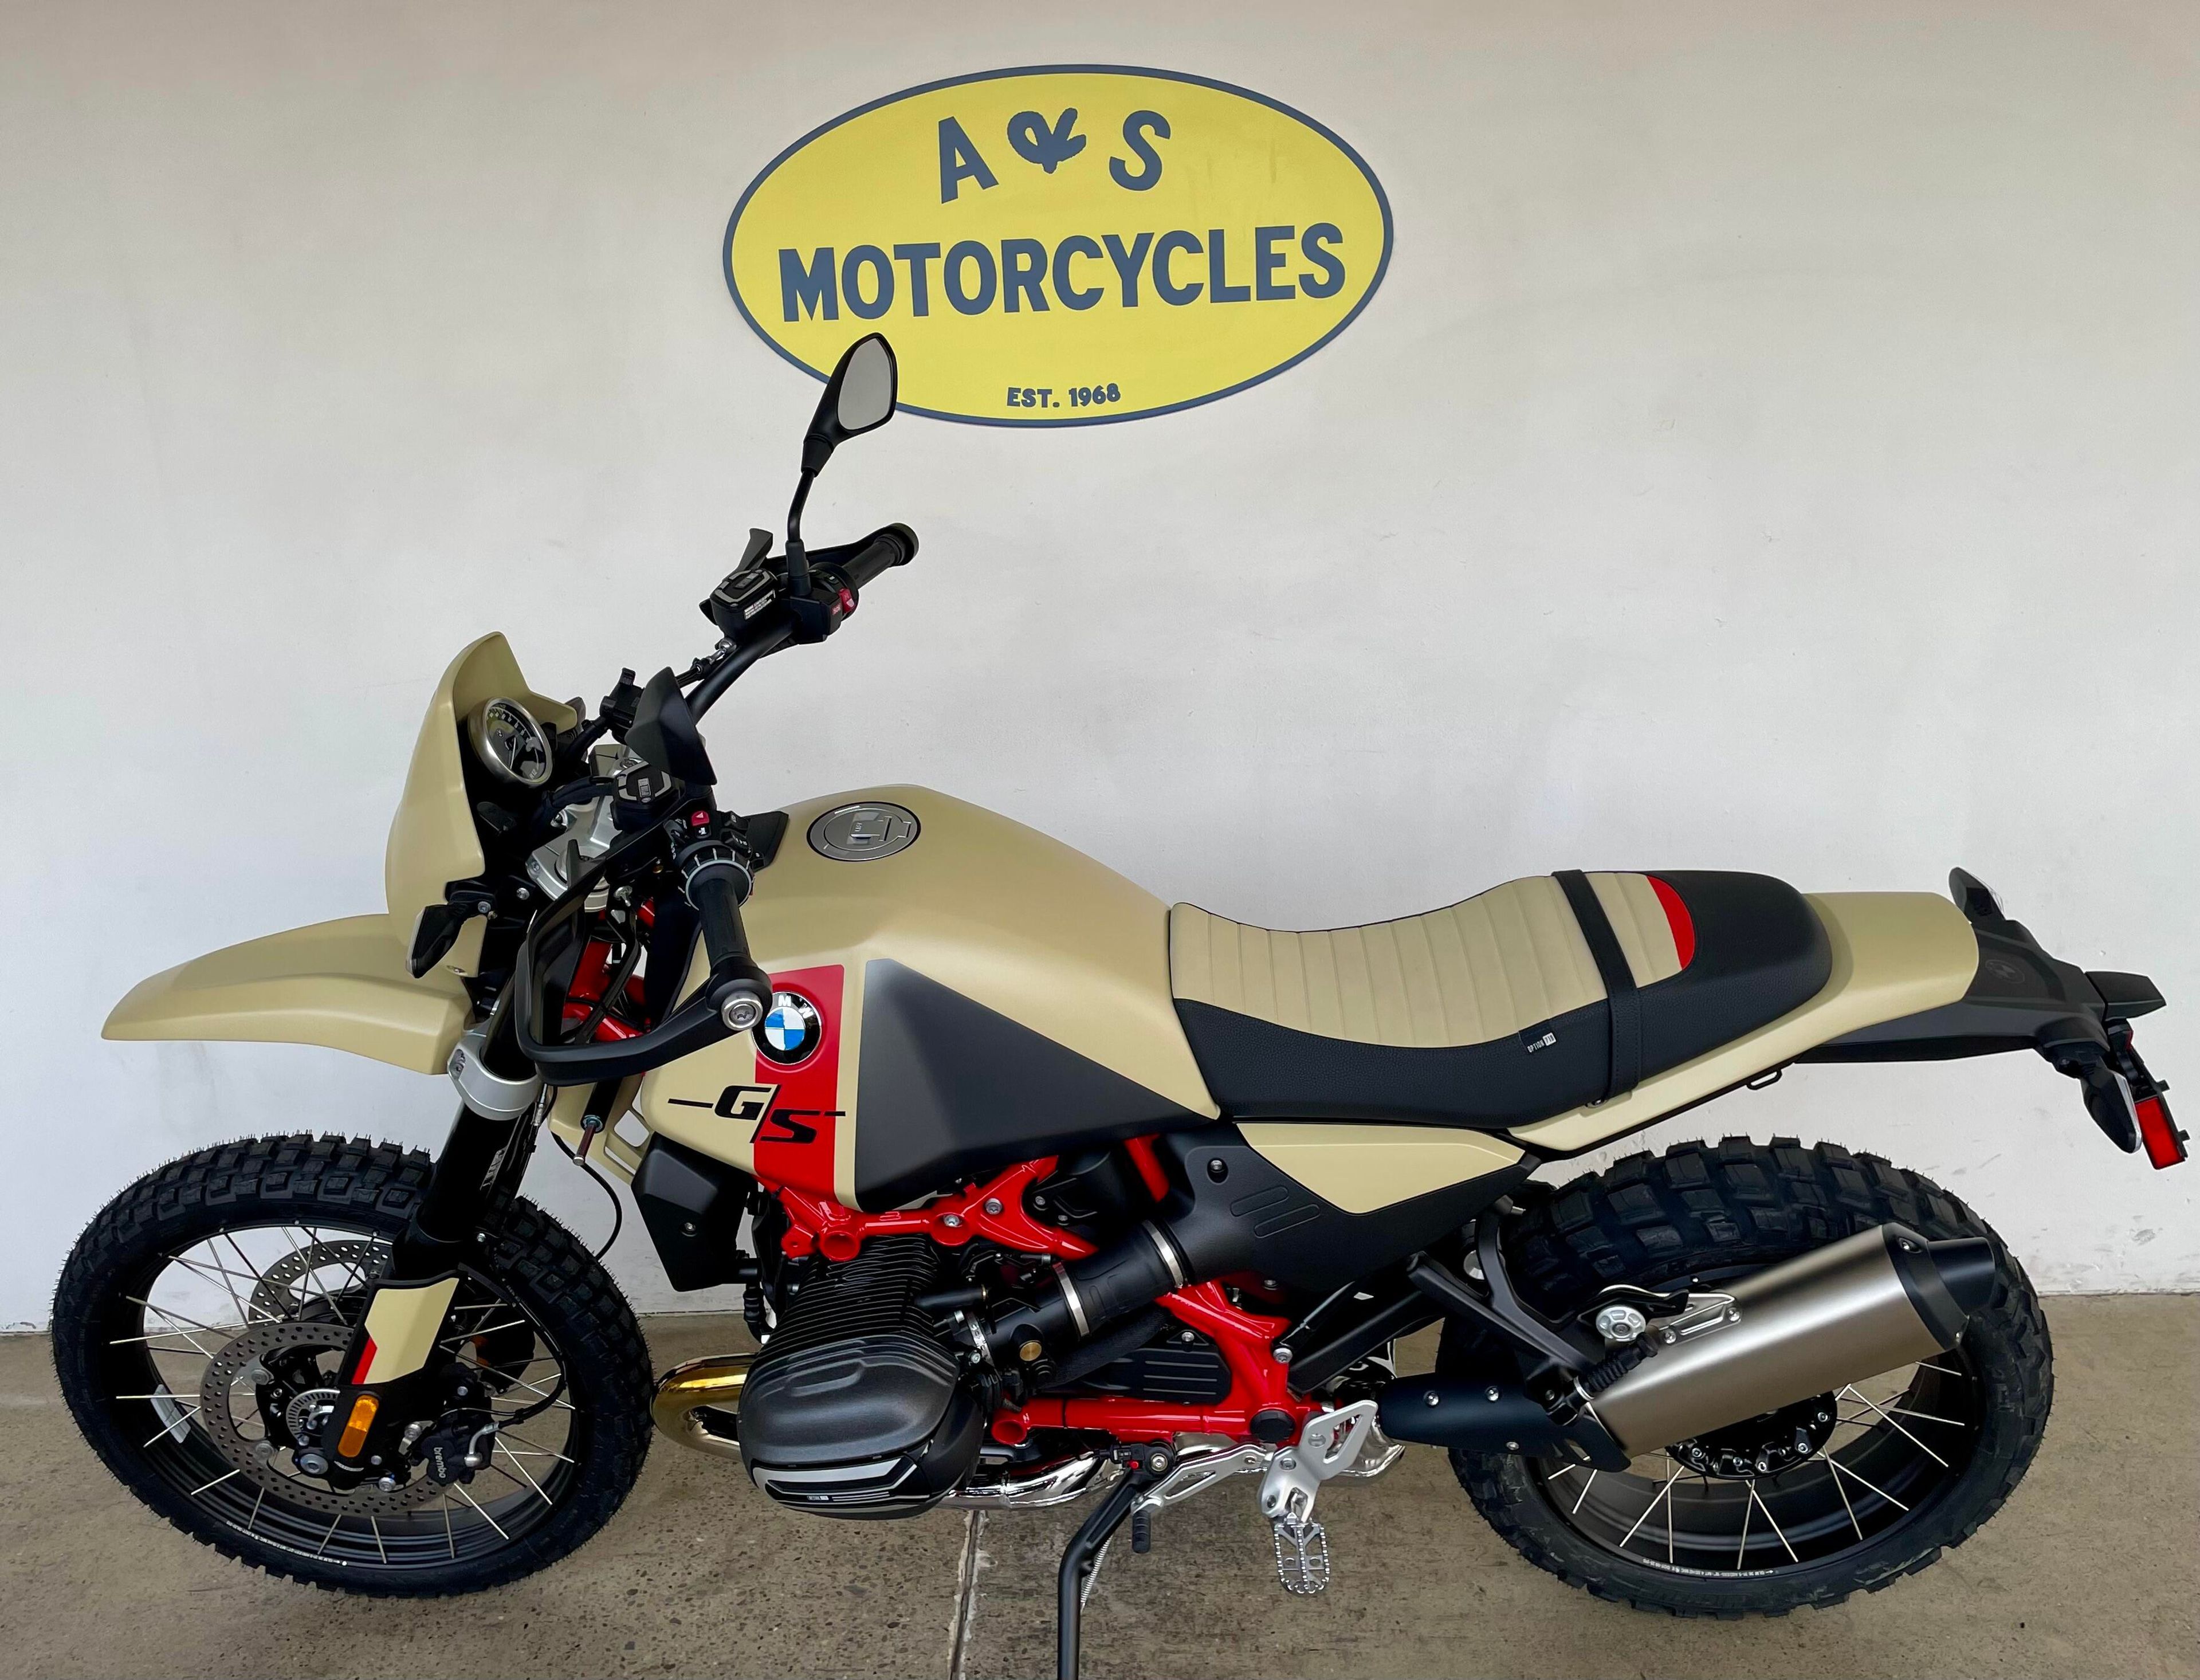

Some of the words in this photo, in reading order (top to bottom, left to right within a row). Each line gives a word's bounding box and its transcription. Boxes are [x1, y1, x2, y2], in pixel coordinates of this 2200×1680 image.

[938, 116, 999, 204] A
[1109, 111, 1170, 191] S
[779, 222, 1346, 323] MOTORCYCLES
[1007, 387, 1060, 407] EST.
[1069, 383, 1121, 407] 1968
[1527, 1039, 1545, 1053] OPTION
[433, 1447, 447, 1478] brembo
